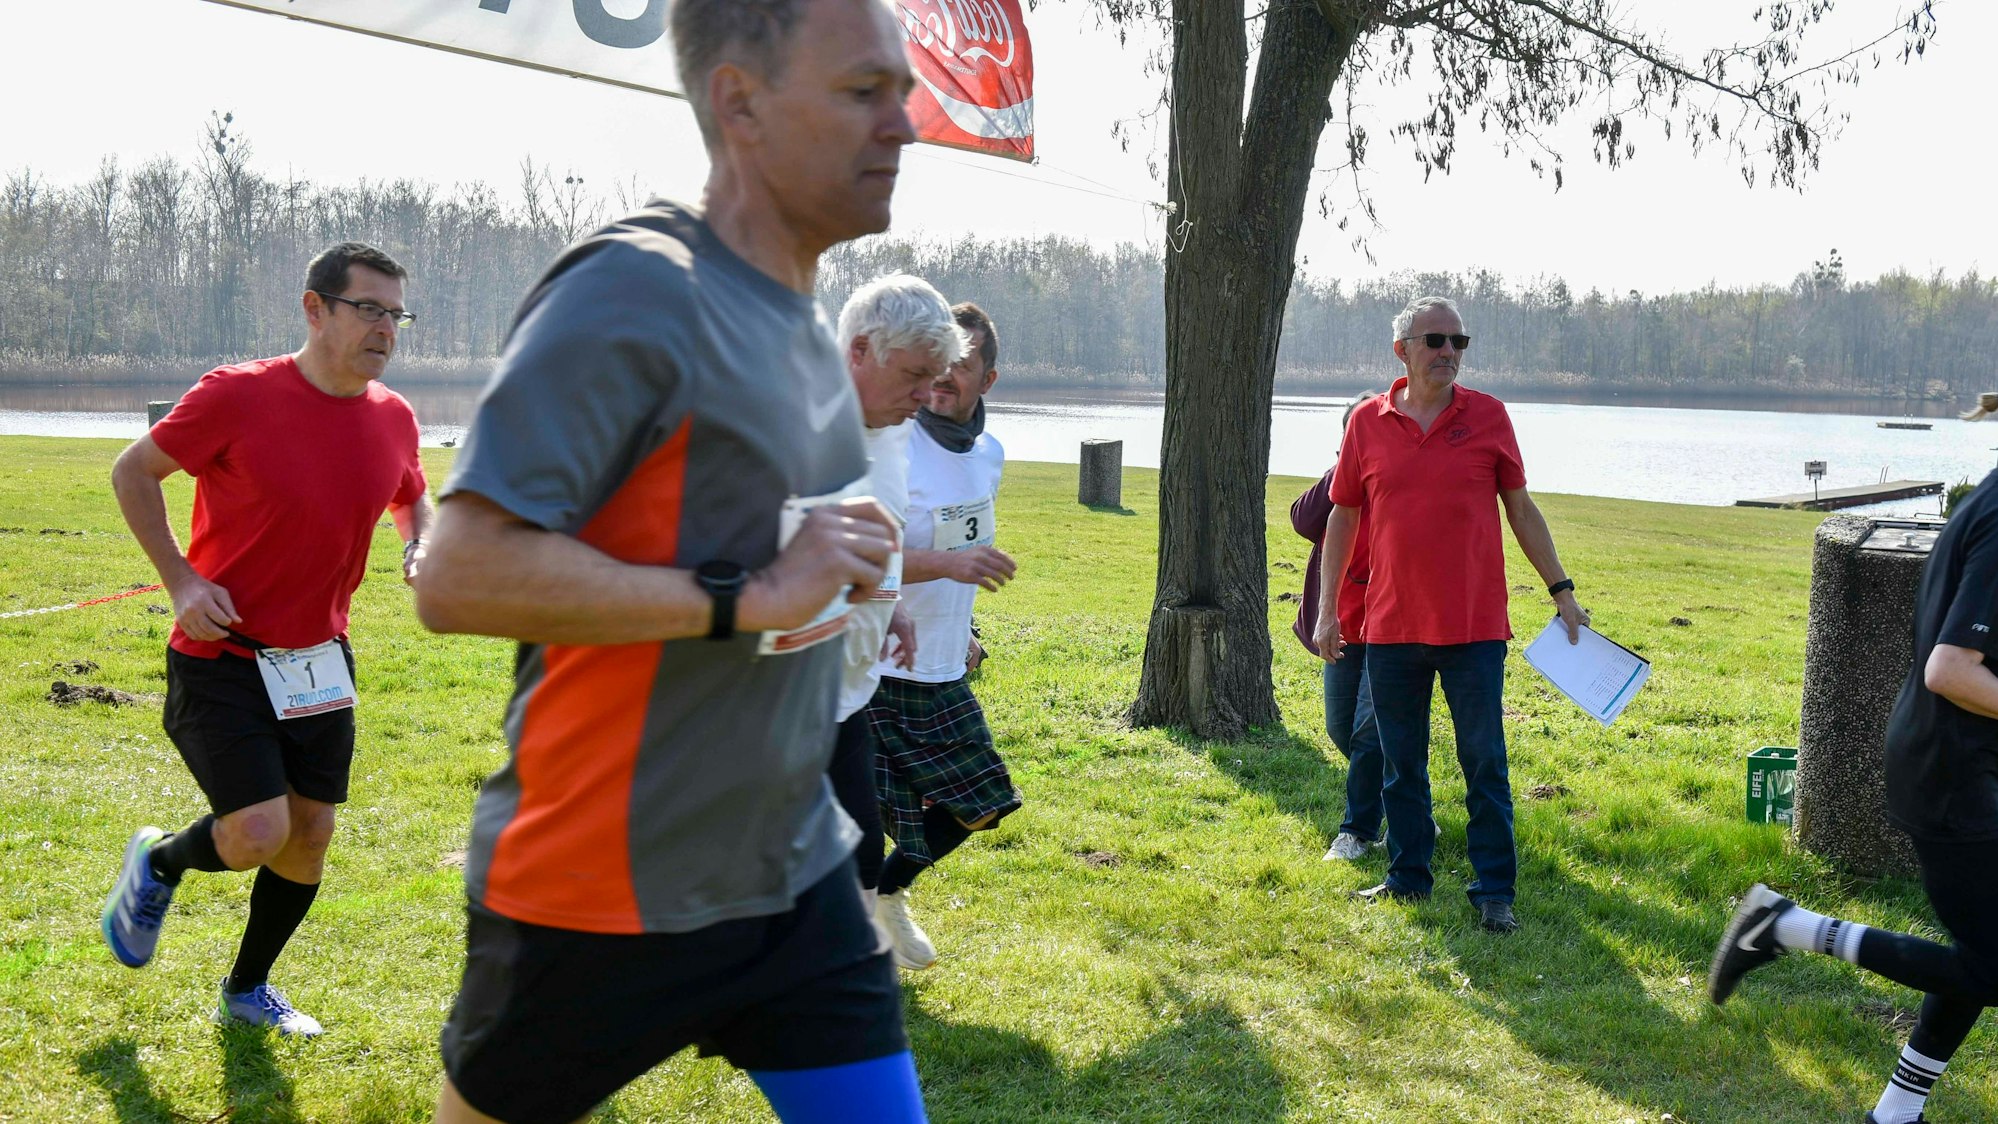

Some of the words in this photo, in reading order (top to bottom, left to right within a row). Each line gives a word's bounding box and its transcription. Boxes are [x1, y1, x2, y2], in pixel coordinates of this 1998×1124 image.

[965, 516, 978, 541] 3
[304, 661, 316, 689] 1
[1751, 768, 1763, 798] EIFEL
